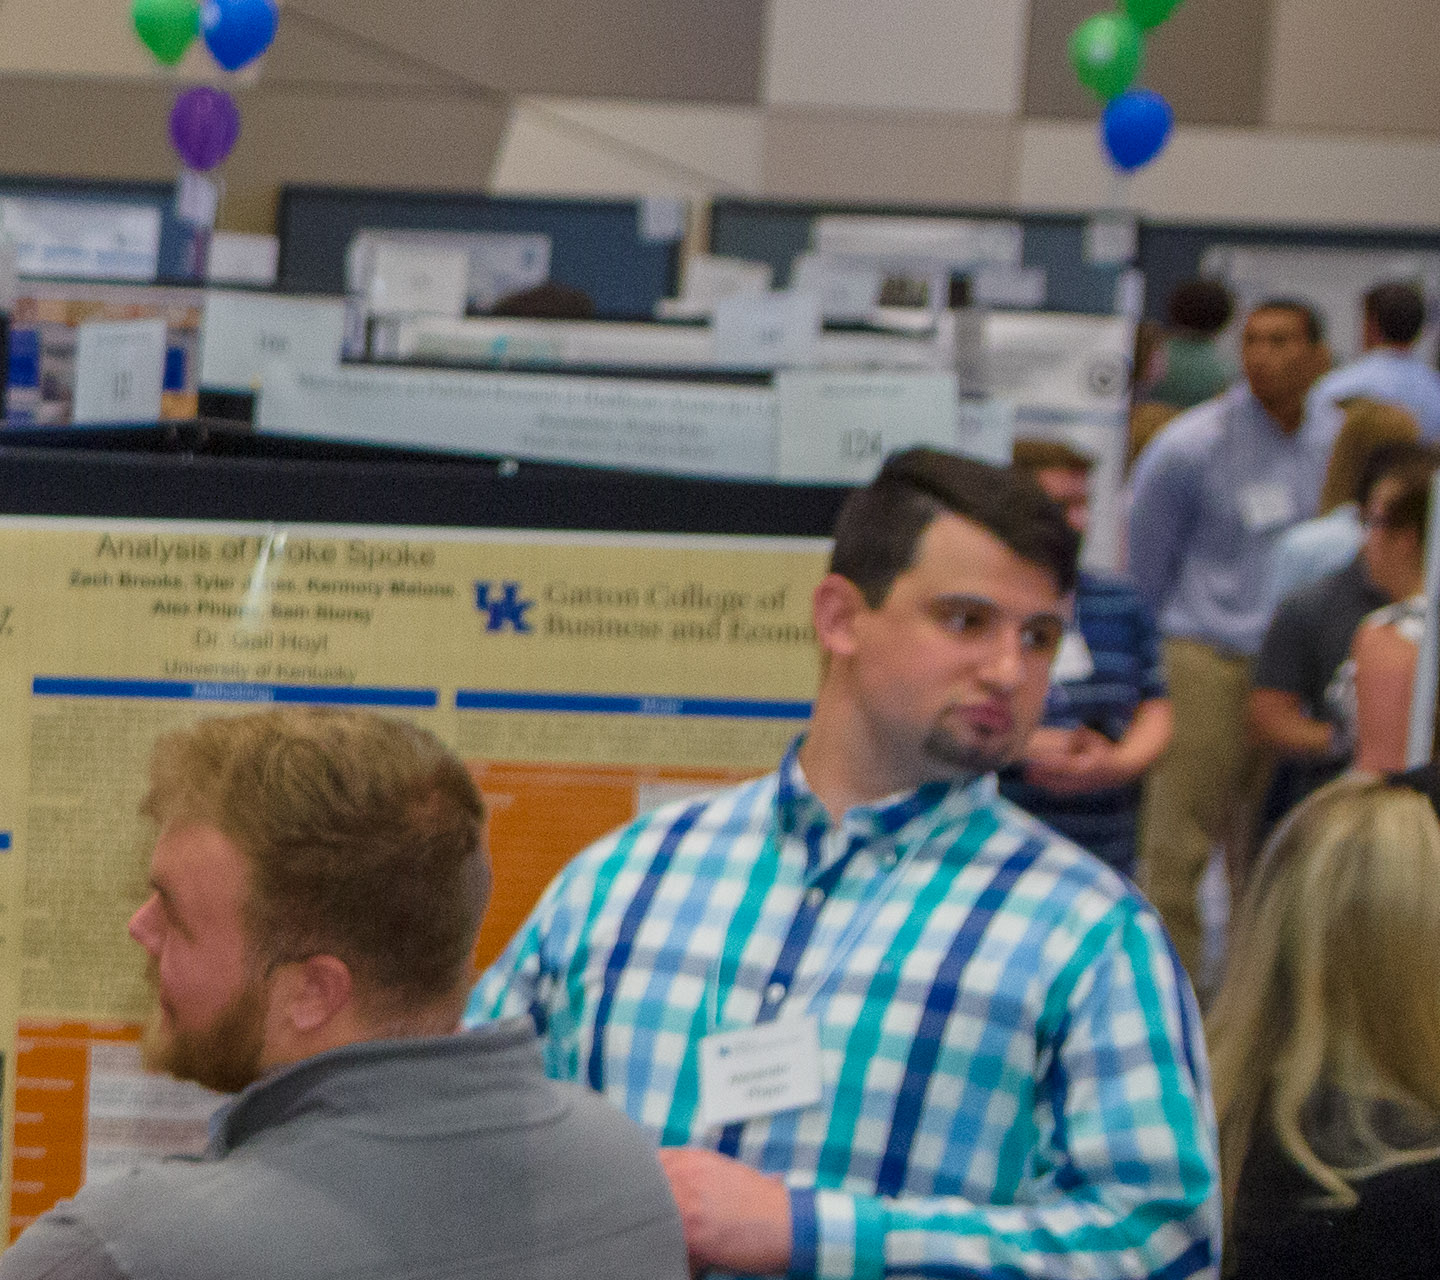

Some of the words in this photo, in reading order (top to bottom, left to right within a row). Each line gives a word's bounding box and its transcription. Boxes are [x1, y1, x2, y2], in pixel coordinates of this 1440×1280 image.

[97, 533, 211, 565] Analysis
[221, 538, 248, 561] of
[347, 539, 436, 569] Spoke
[542, 580, 640, 607] Gatton
[645, 580, 746, 616] College
[755, 584, 788, 611] of
[544, 613, 664, 637] Business
[670, 616, 722, 641] and
